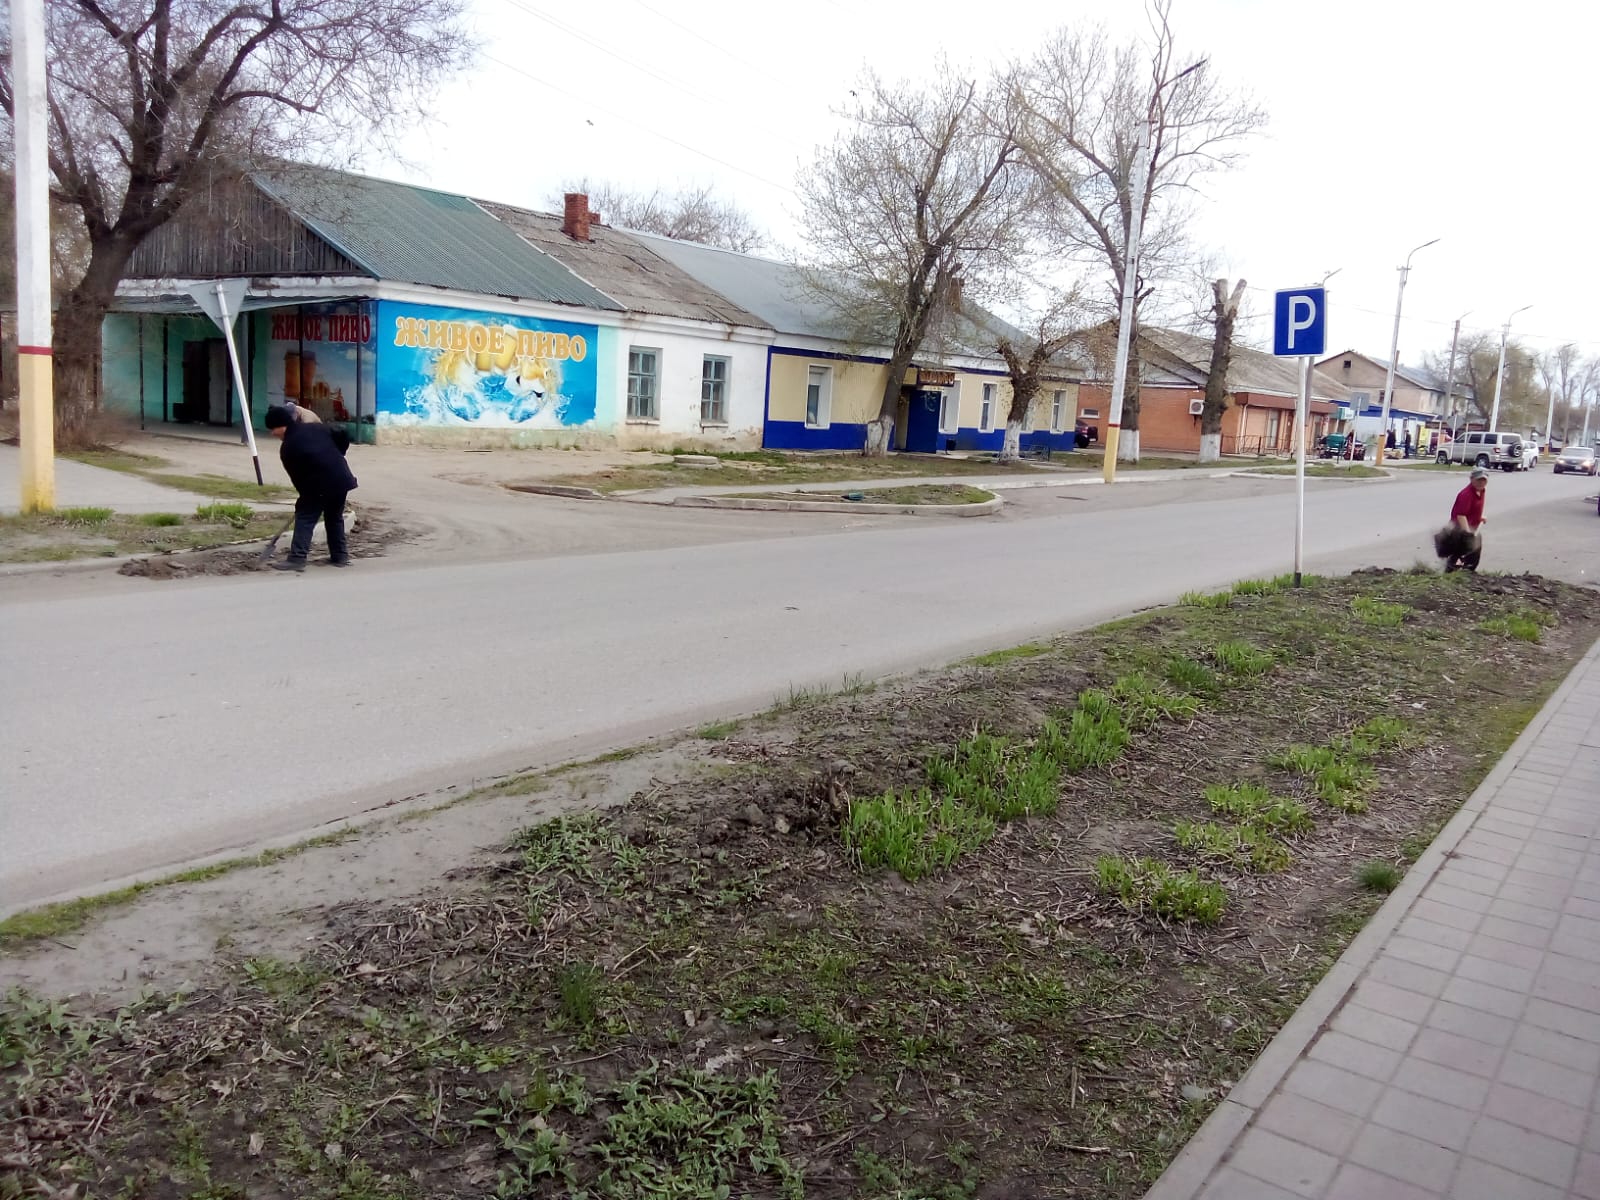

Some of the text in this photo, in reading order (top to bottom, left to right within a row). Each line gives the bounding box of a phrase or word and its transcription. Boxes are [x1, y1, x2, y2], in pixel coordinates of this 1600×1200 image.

[328, 314, 371, 343] ПИВО
[394, 316, 586, 362] ЖИВОЕ ПИВО
[1287, 295, 1316, 349] P
